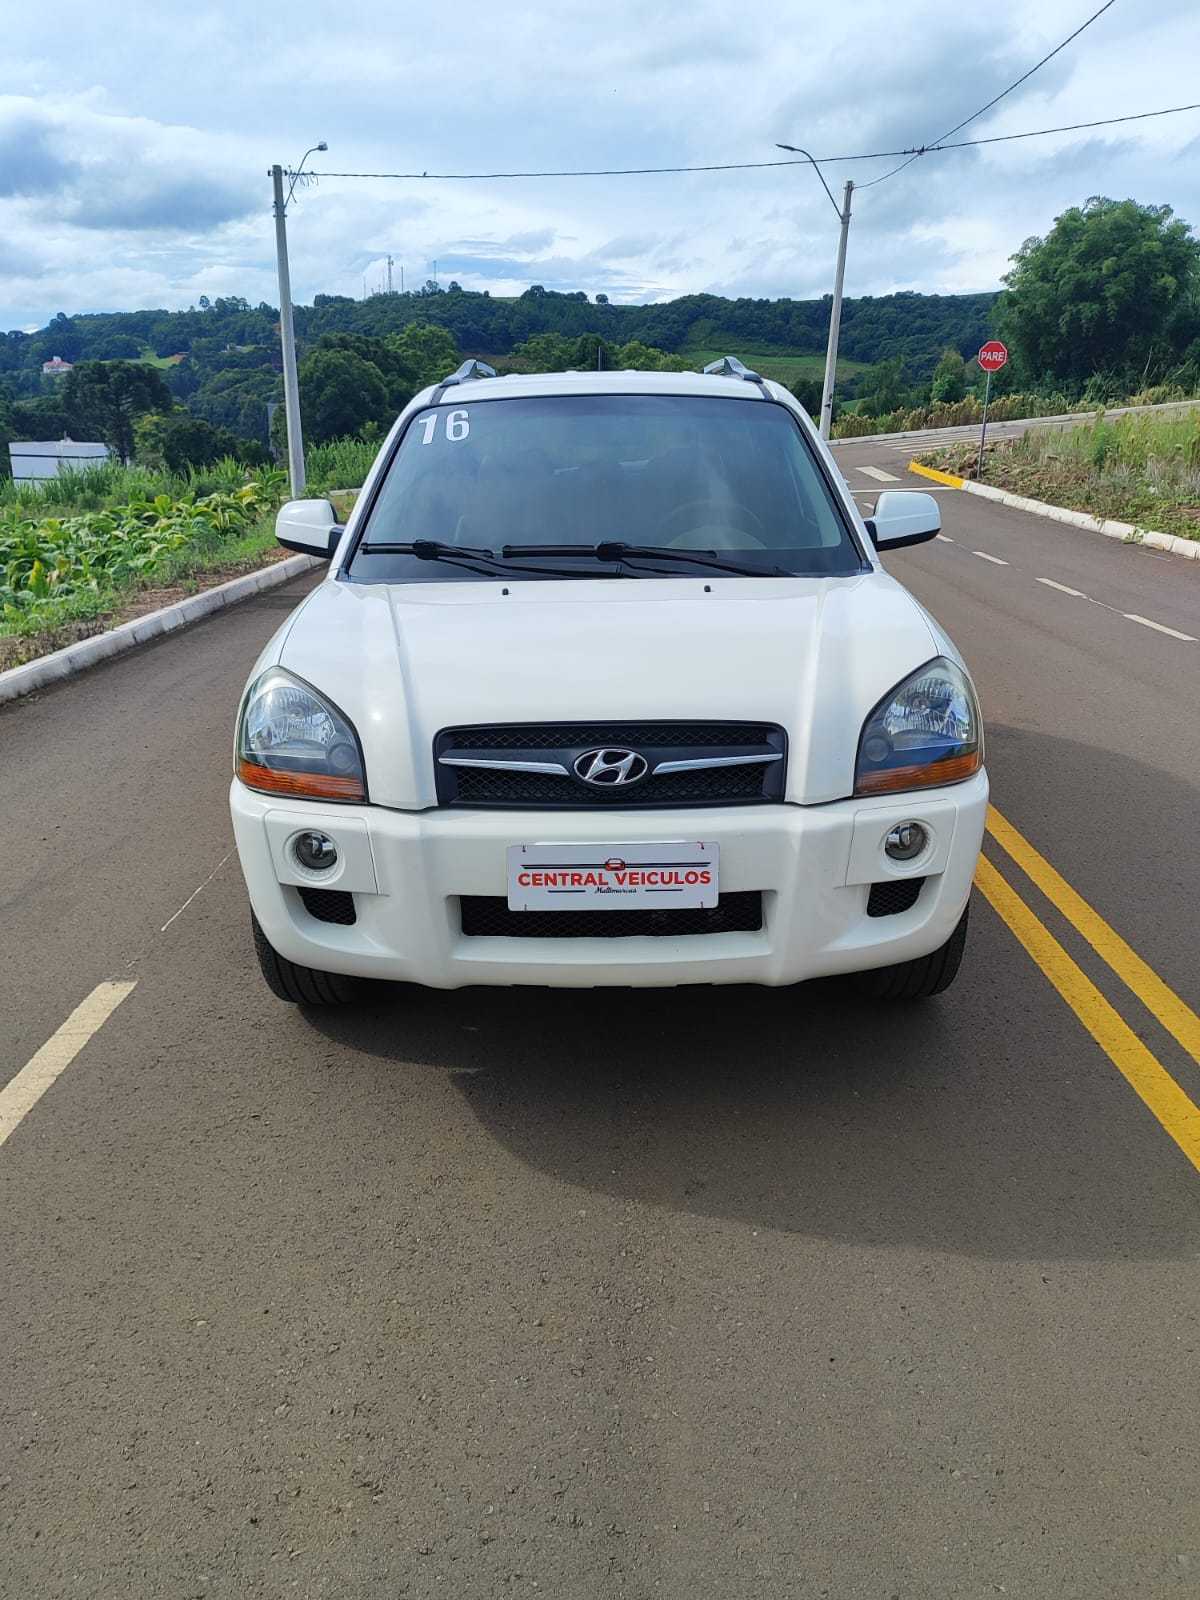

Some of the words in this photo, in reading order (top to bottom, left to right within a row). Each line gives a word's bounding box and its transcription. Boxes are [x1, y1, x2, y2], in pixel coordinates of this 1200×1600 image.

[981, 351, 1004, 361] PARE
[418, 409, 470, 445] 16
[518, 872, 609, 886] CENTRAL
[614, 871, 711, 885] VEICULOS
